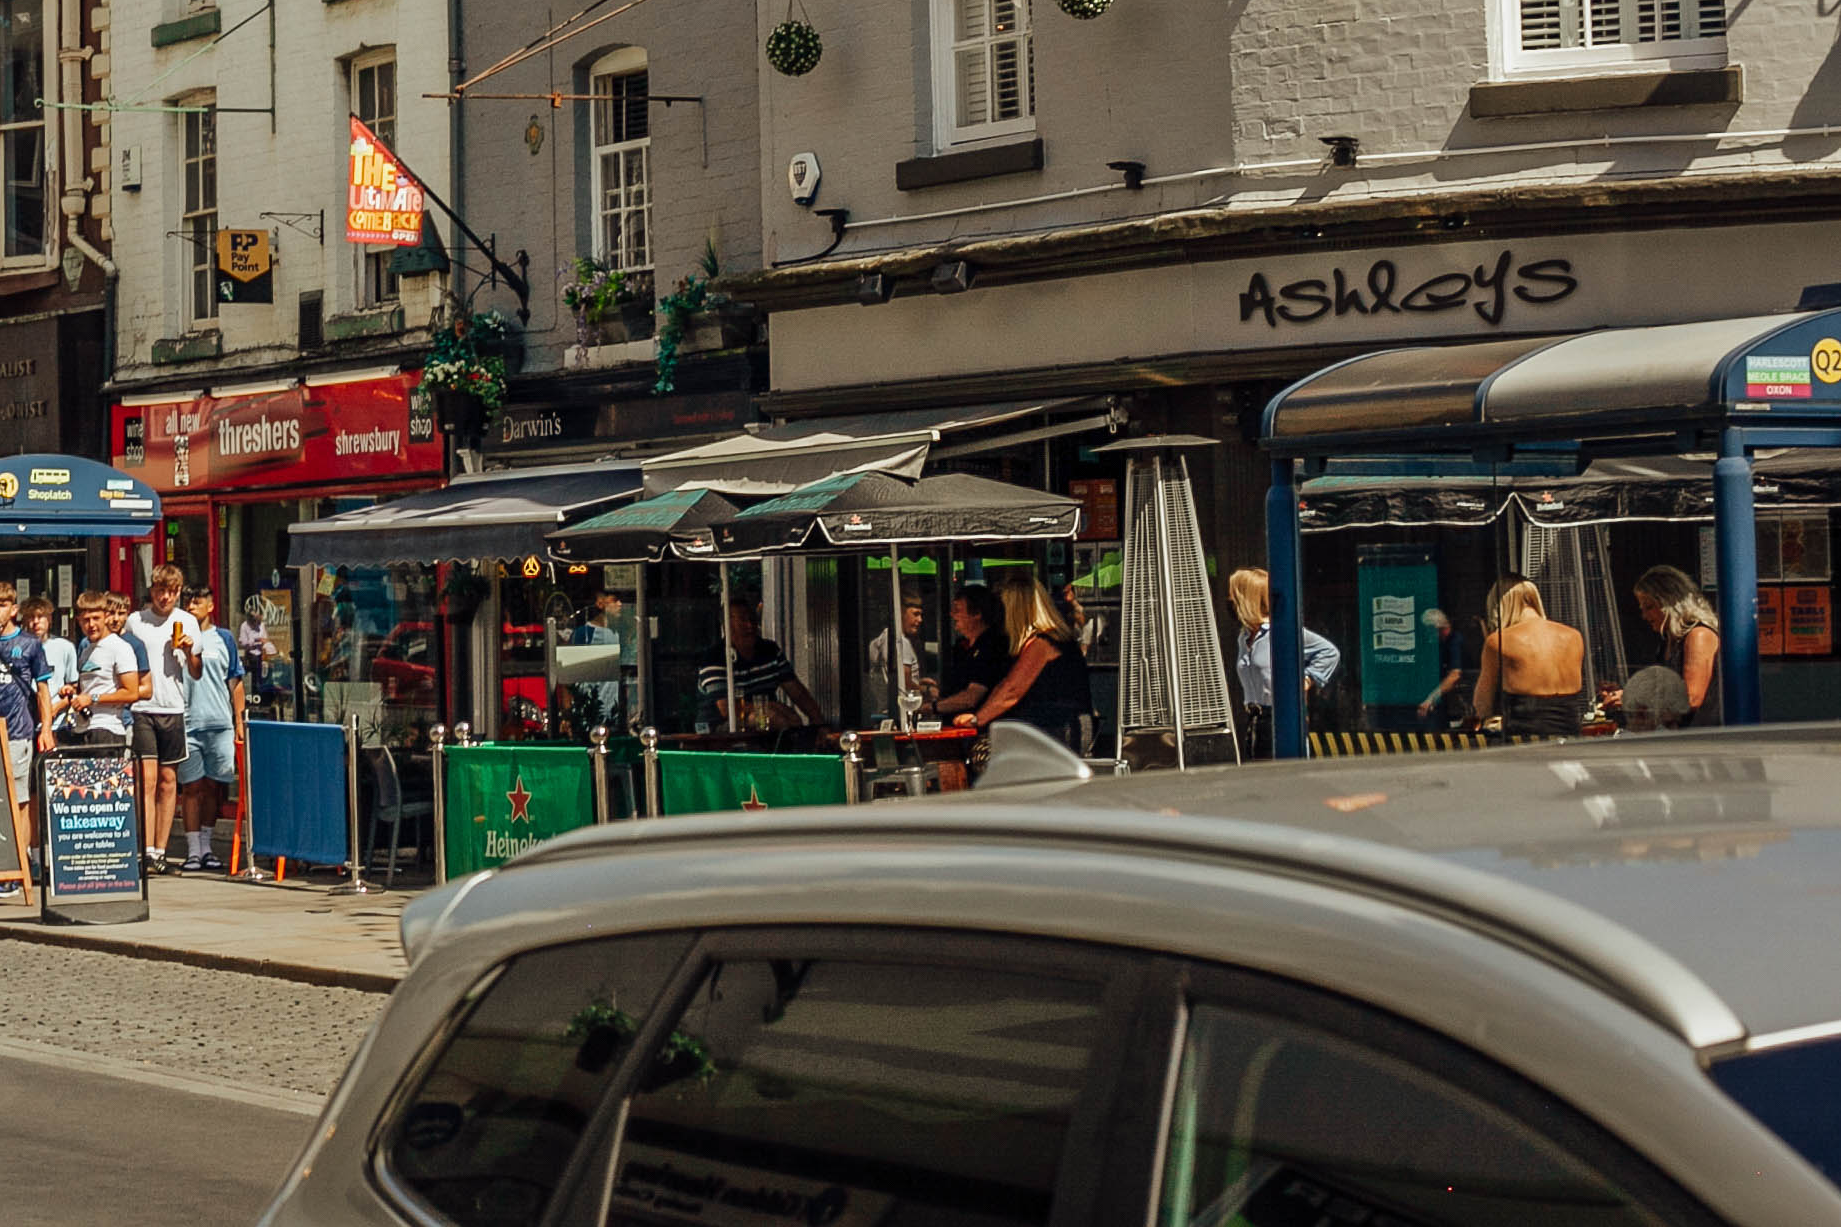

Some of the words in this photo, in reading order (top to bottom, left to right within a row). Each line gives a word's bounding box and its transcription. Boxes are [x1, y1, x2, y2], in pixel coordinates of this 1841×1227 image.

[350, 143, 397, 192] THE
[231, 252, 249, 263] Pay
[231, 262, 259, 272] Point
[1815, 349, 1841, 376] Q2
[1766, 384, 1793, 395] OXON
[126, 420, 144, 438] wine
[165, 409, 178, 435] all
[180, 413, 201, 432] new
[410, 416, 432, 439] shop
[502, 412, 562, 443] Darwin's
[218, 414, 300, 455] threshers
[336, 426, 401, 455] shrewsbury
[126, 442, 145, 464] shop
[28, 488, 71, 500] Shoplatch
[52, 803, 70, 814] We
[71, 805, 89, 814] are
[89, 803, 113, 816] open
[114, 800, 131, 812] for
[60, 814, 126, 831] takeaway
[58, 833, 71, 843] you
[71, 833, 84, 841] are
[84, 831, 114, 840] welcome
[114, 830, 123, 839] to
[123, 829, 131, 838] sit
[74, 842, 82, 850] at
[83, 841, 95, 850] our
[95, 839, 116, 849] tables
